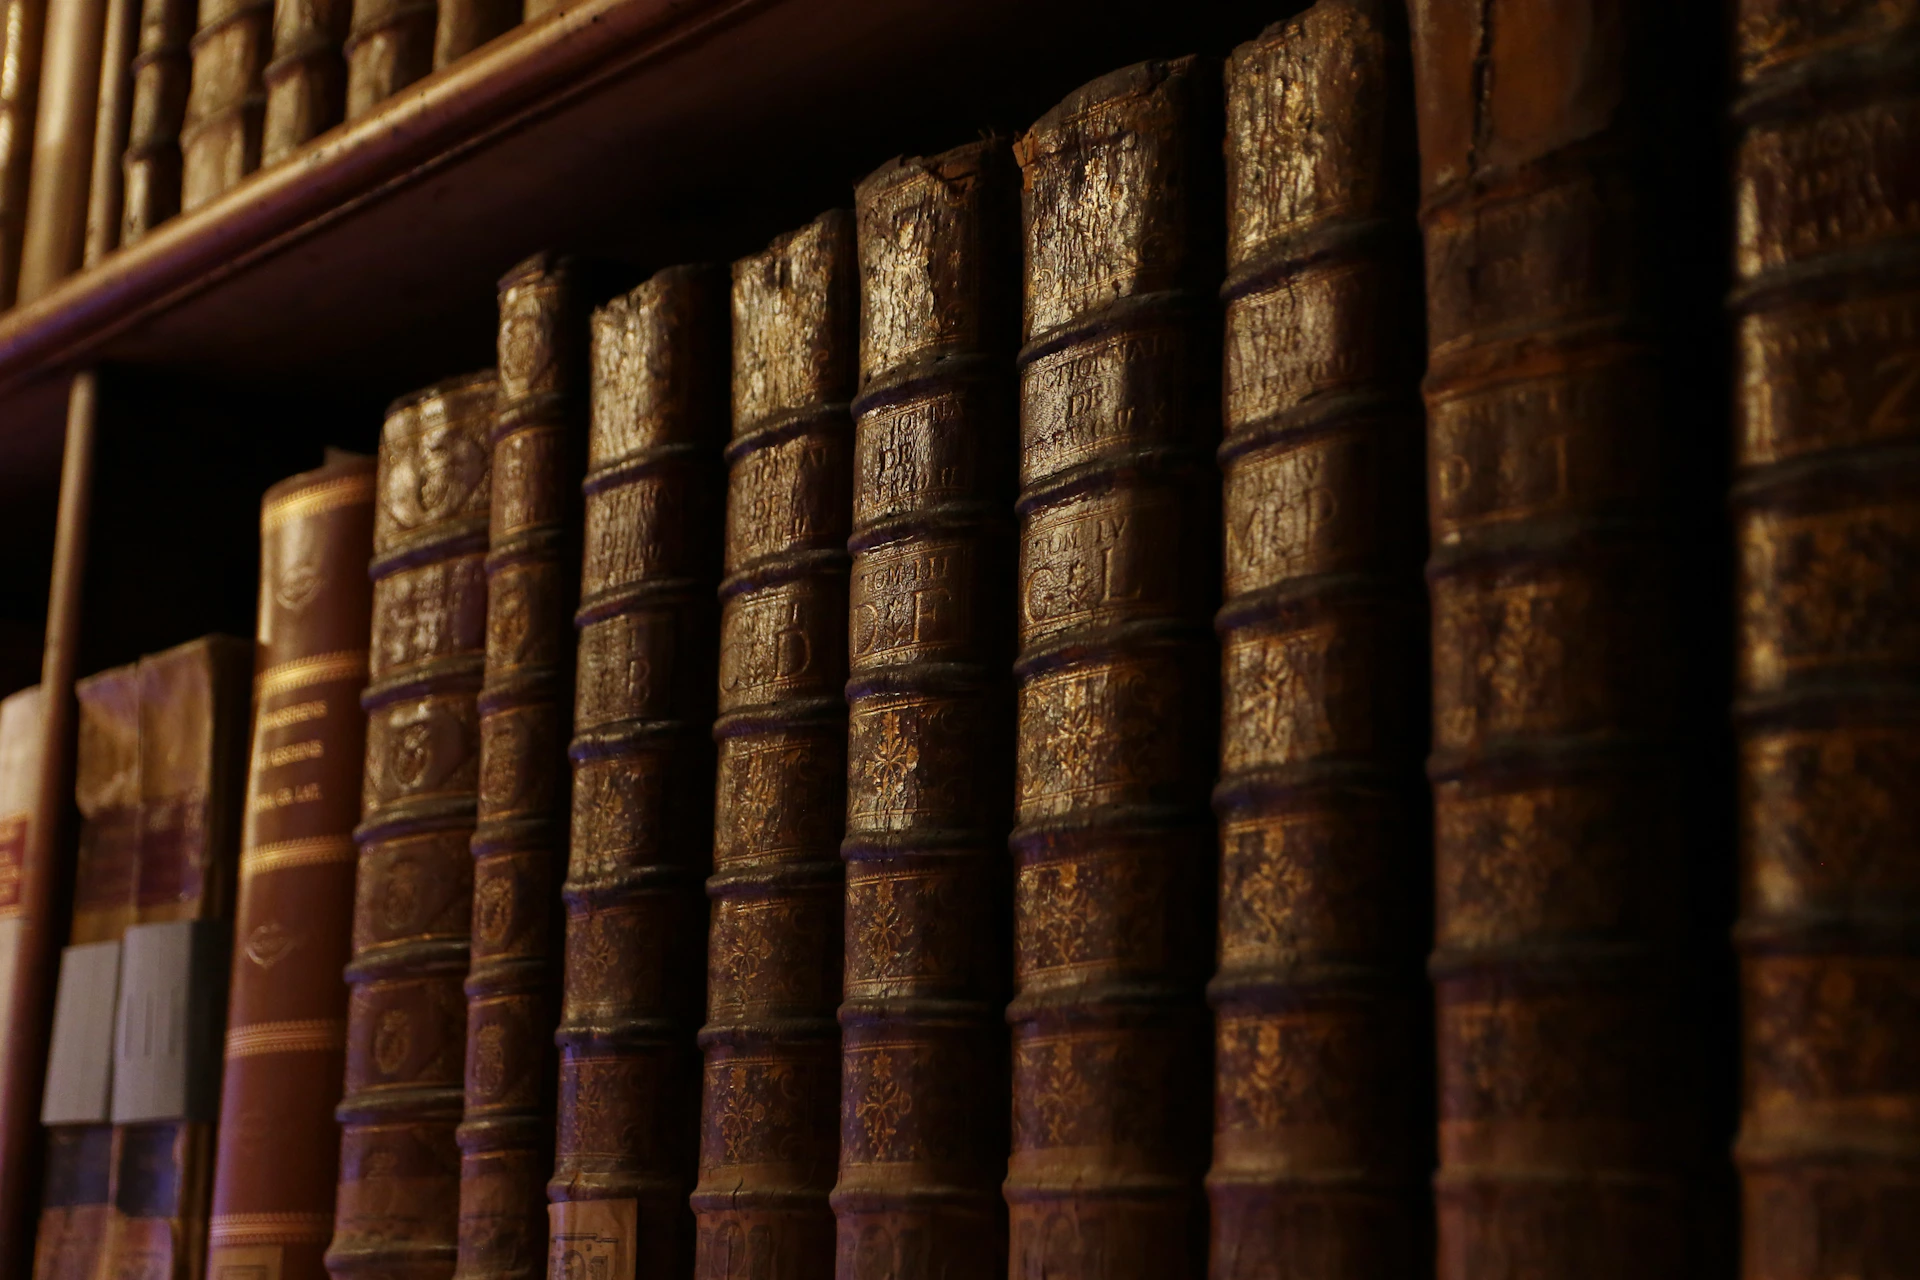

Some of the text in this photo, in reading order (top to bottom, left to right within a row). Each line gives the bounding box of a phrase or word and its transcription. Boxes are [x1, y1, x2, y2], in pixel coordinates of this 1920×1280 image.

[1070, 386, 1104, 418] DE
[1035, 516, 1129, 556] TOM IV
[862, 564, 903, 592] TOM
[1100, 545, 1143, 602] L
[852, 587, 952, 658] D F
[773, 627, 812, 681] D
